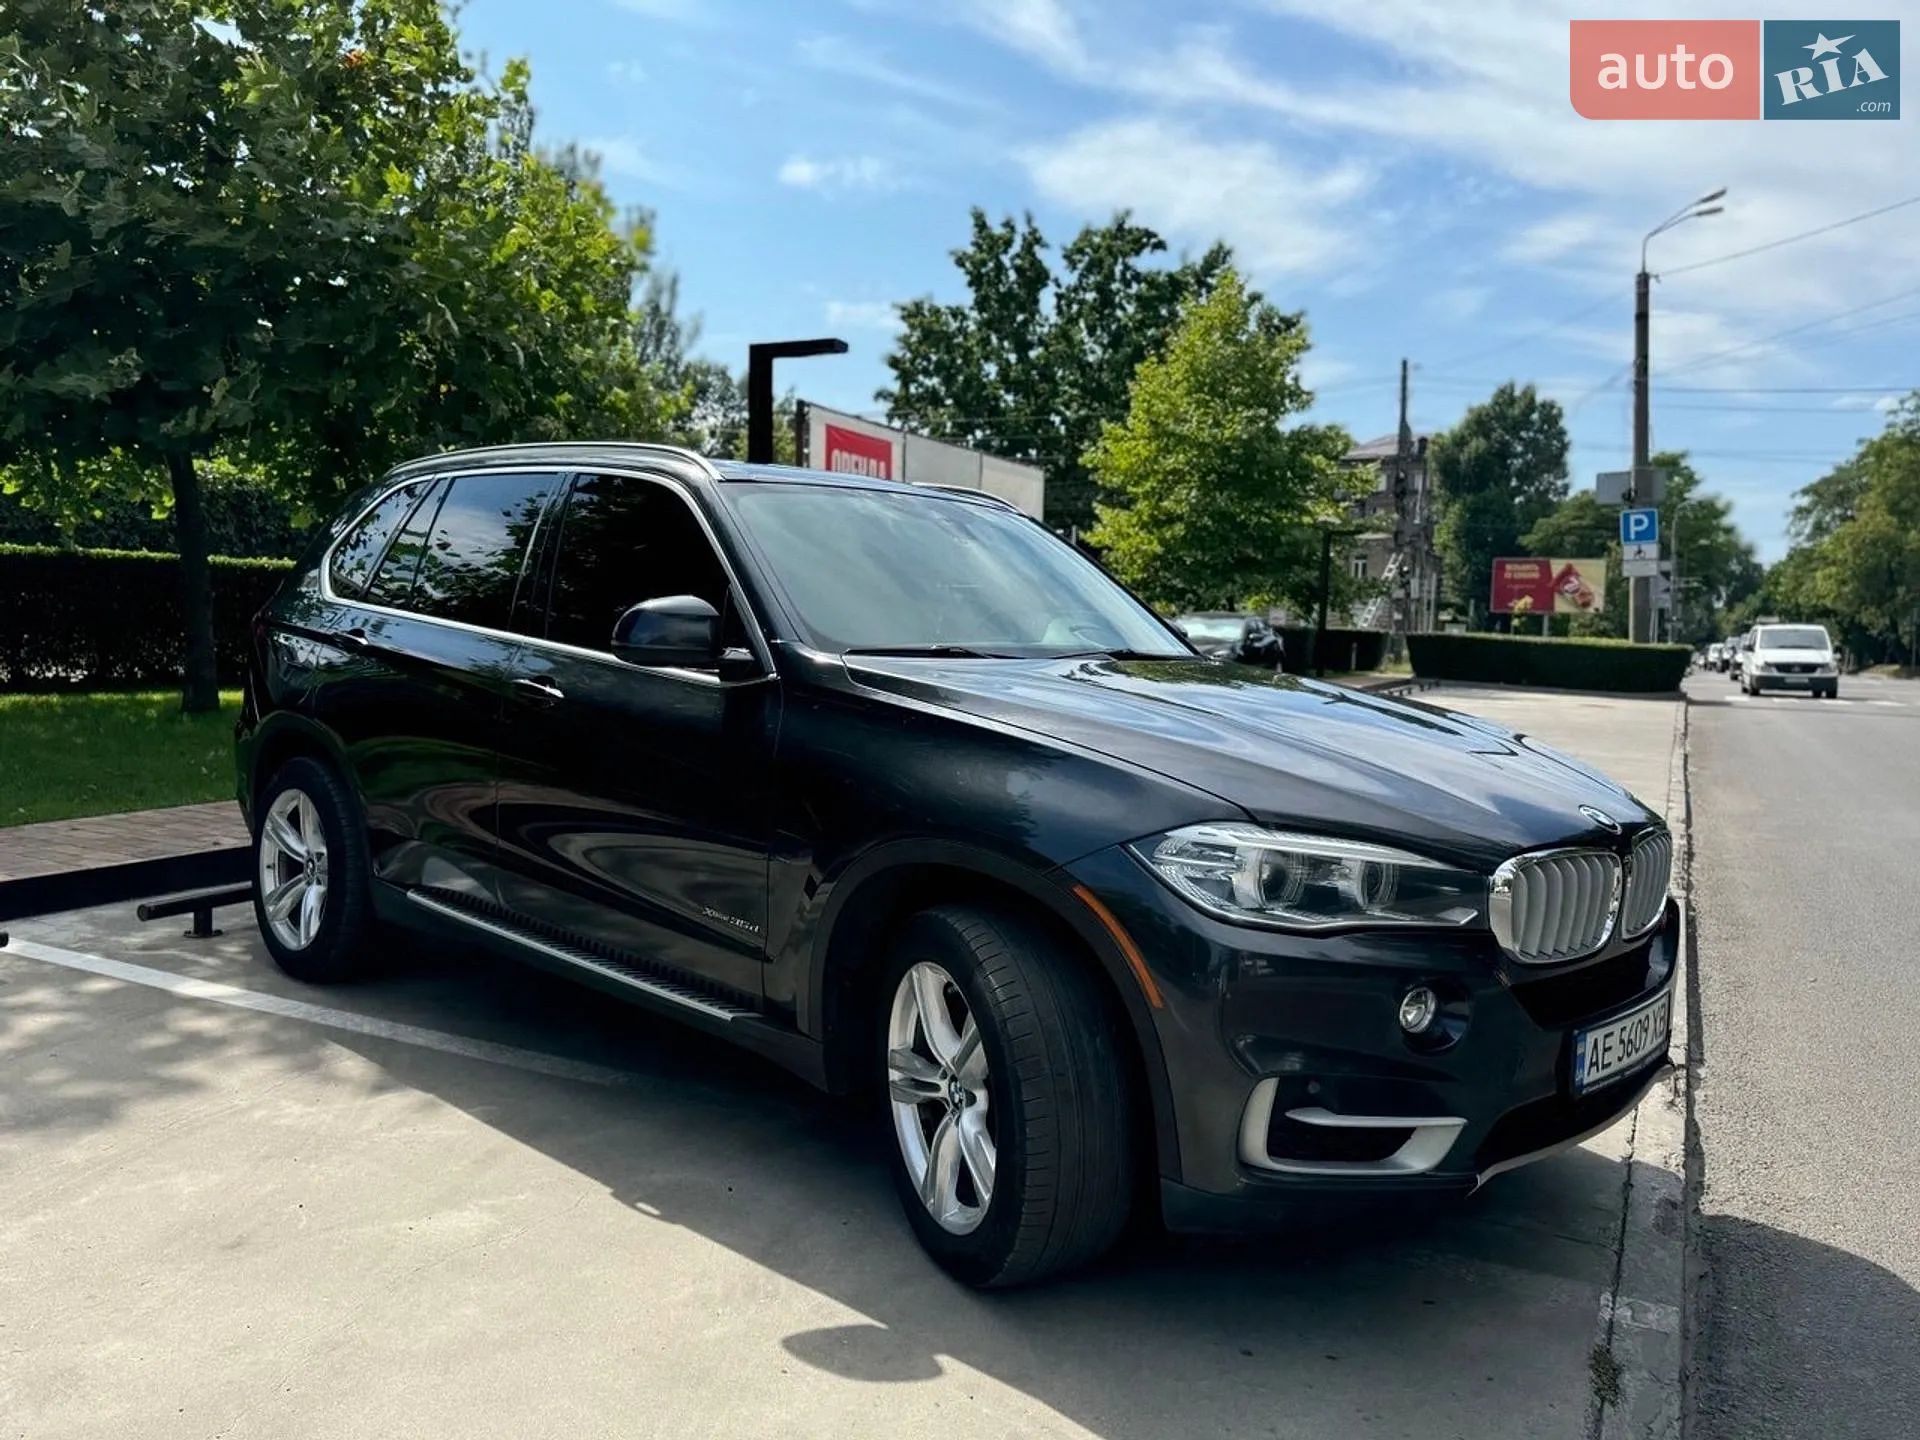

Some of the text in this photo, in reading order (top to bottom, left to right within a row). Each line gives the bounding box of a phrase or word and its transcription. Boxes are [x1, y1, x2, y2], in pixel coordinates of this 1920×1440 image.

[1629, 514, 1649, 540] P
[1587, 1031, 1614, 1076] AE
[1617, 1013, 1650, 1062] 5609
